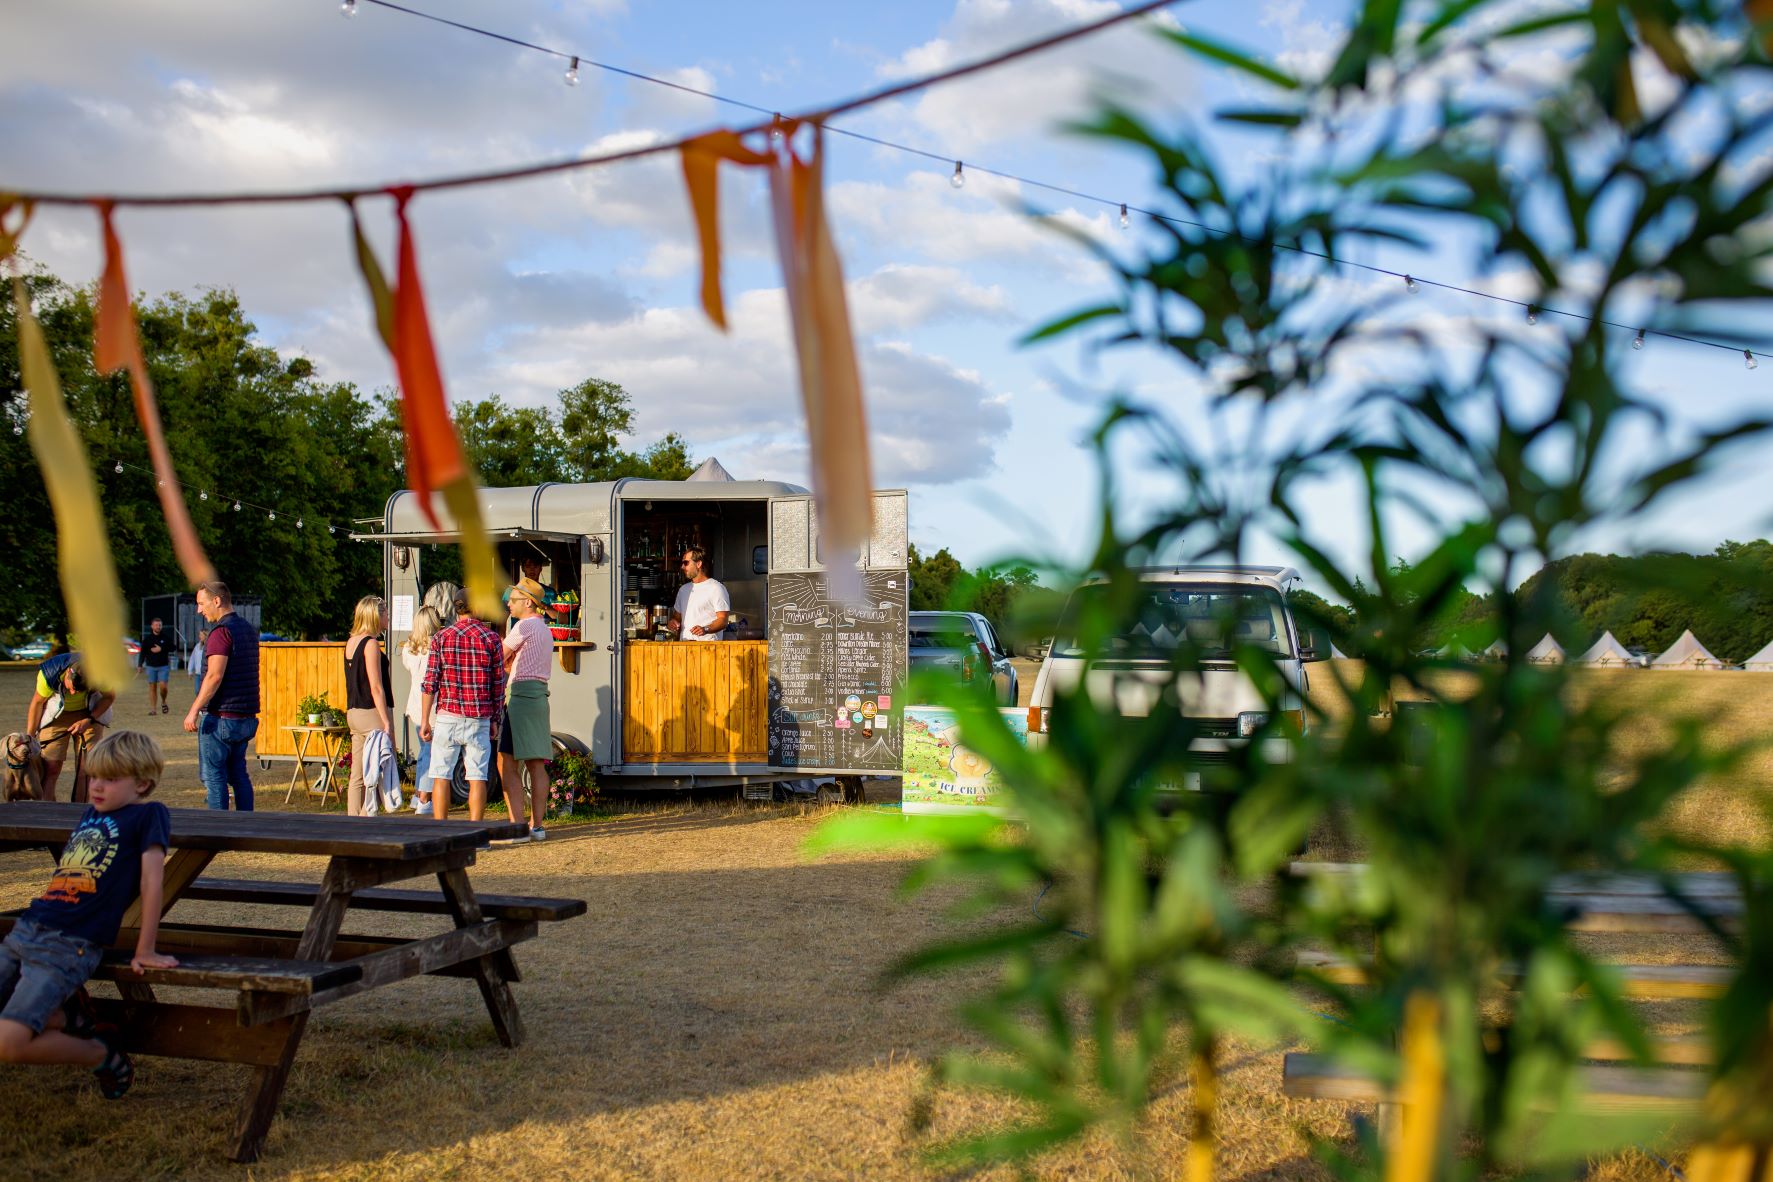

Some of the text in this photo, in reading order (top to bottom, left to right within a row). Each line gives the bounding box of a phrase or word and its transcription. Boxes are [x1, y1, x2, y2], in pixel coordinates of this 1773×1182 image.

[941, 782, 955, 792] ICE
[102, 816, 120, 839] PALM
[92, 843, 119, 879] TREES
